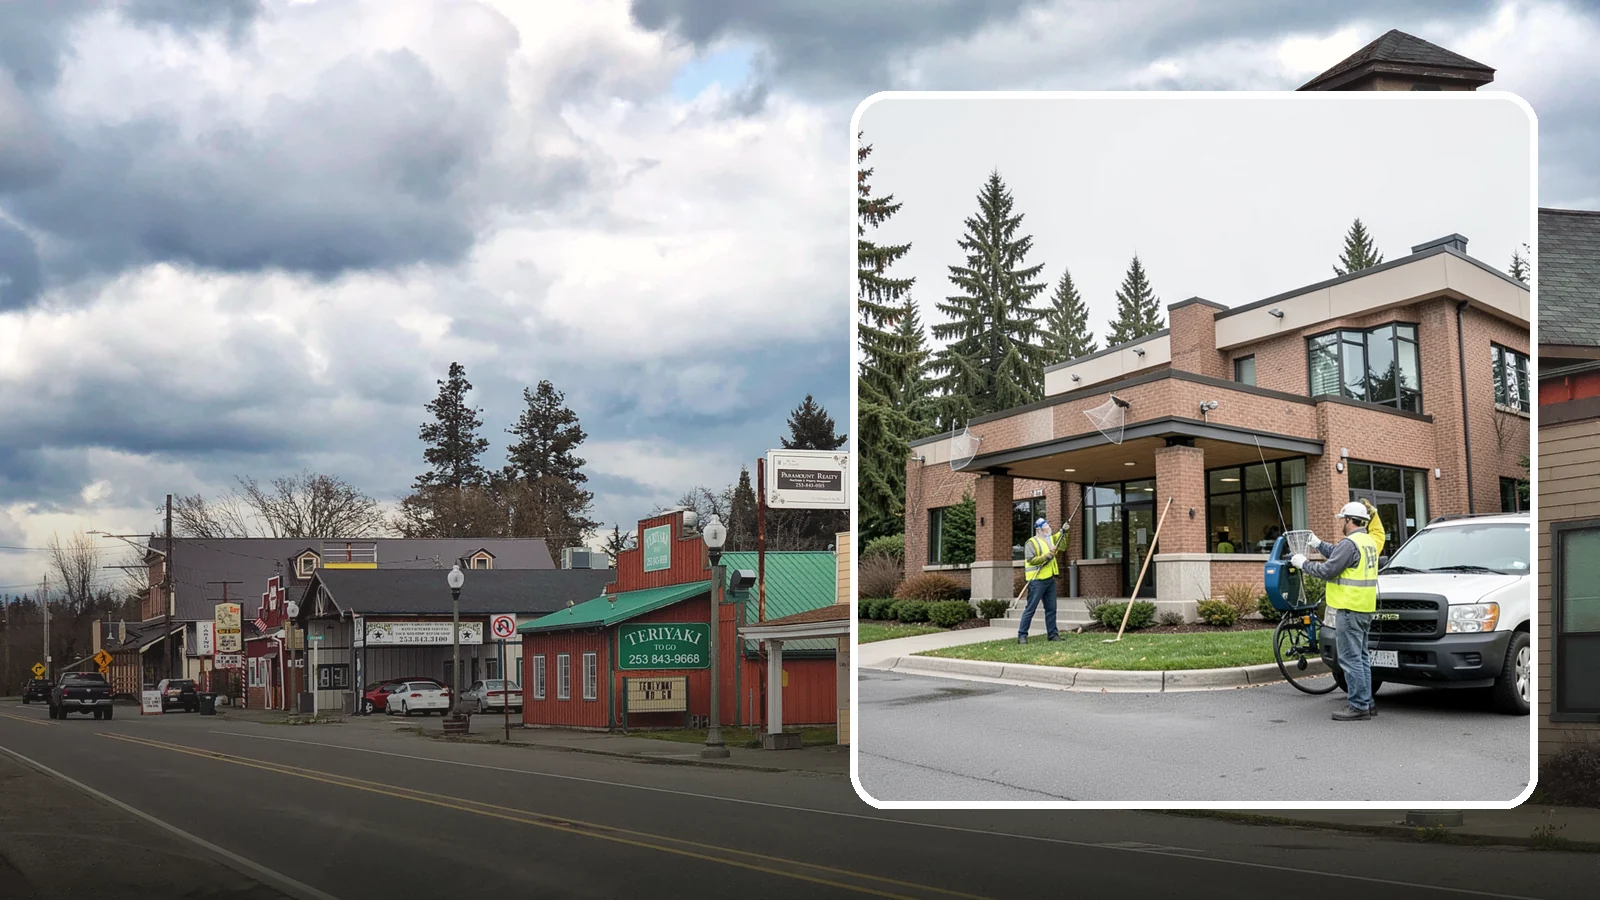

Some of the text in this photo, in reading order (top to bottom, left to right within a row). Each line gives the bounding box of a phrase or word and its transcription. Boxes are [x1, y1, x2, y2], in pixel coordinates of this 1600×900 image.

[781, 471, 815, 480] PARAMOUNT
[817, 472, 839, 480] REALTY
[625, 627, 702, 646] TERIYAKI
[629, 653, 700, 664] 253 843-9668
